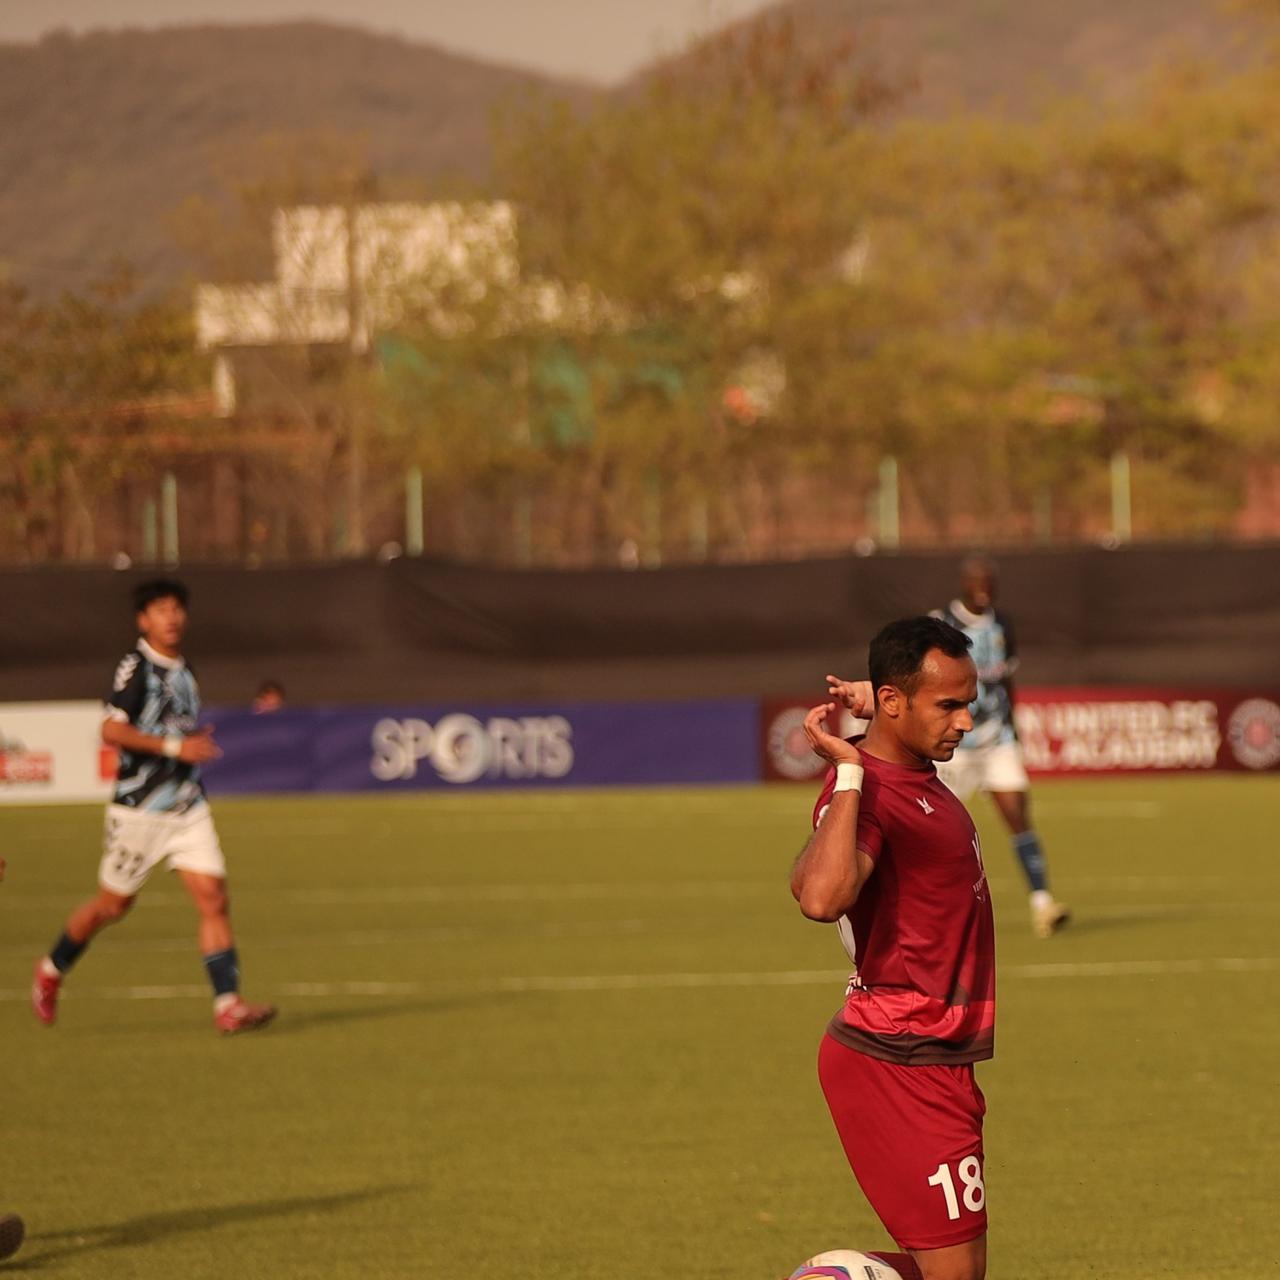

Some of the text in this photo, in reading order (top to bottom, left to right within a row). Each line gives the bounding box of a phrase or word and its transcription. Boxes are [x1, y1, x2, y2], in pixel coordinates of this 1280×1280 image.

[370, 712, 574, 784] SPORTS
[1046, 701, 1169, 735] UNITED
[927, 1155, 985, 1220] 18
